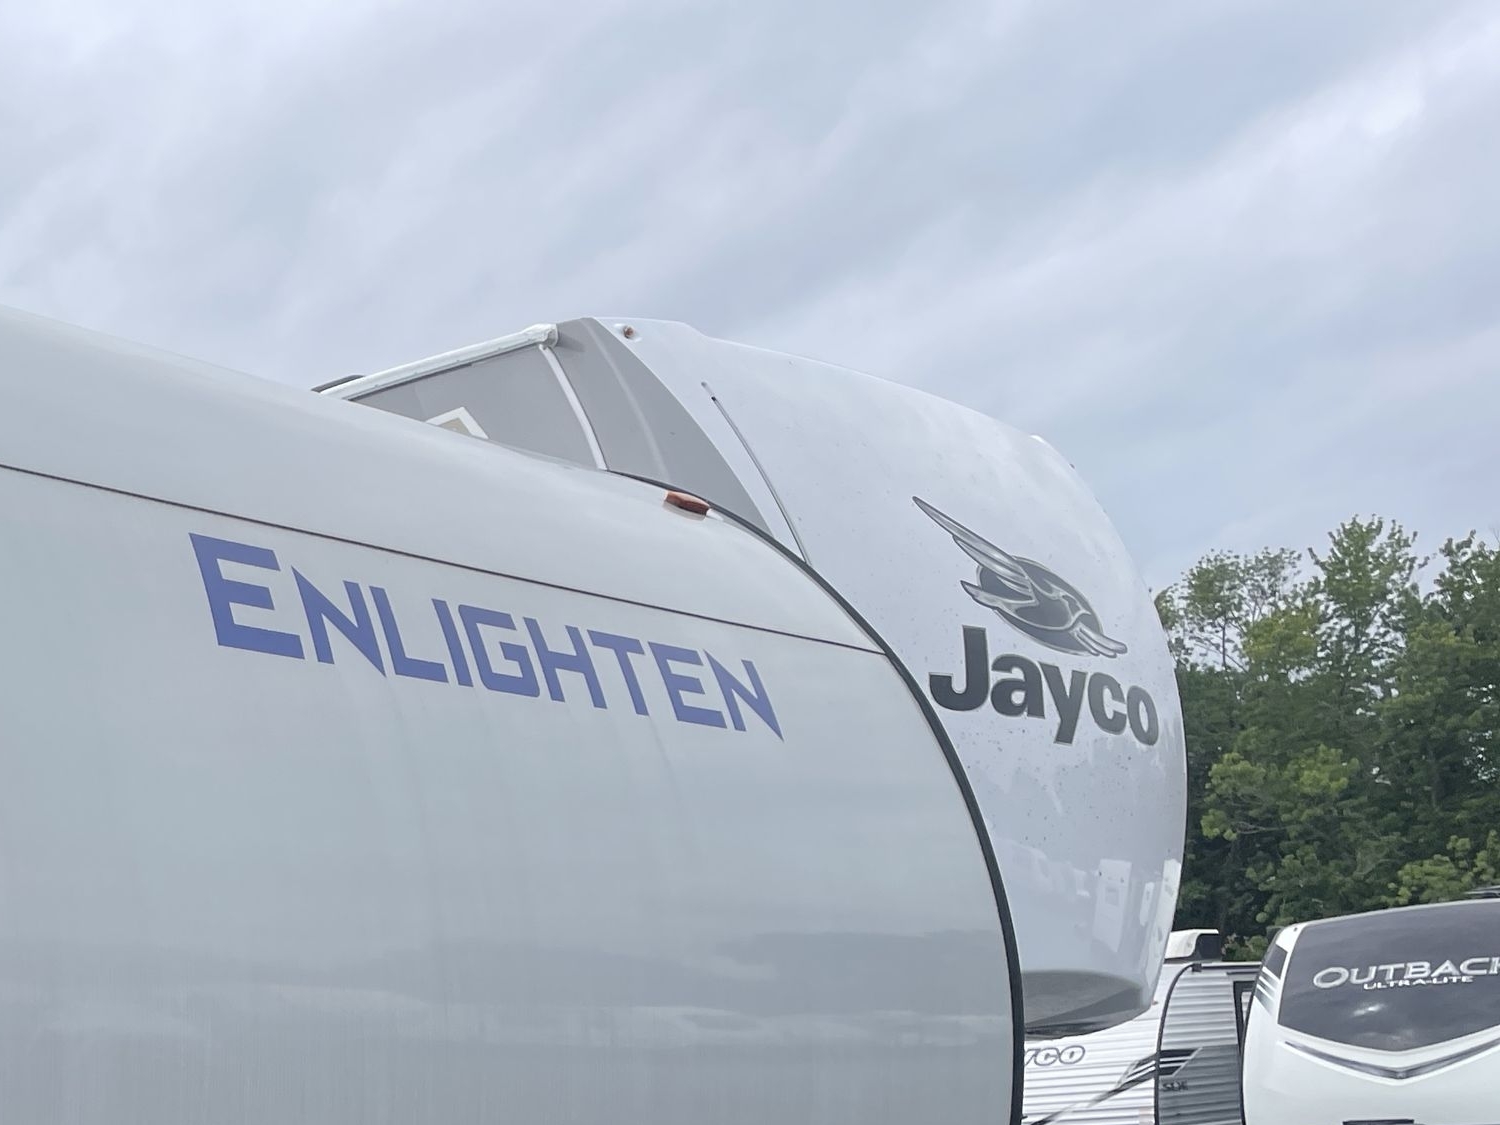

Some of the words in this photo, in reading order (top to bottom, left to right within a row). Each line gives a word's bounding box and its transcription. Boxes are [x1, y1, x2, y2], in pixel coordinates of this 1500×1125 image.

[189, 532, 784, 741] ENLIGHTEN
[928, 625, 1160, 747] Jayco
[1363, 975, 1475, 990] ULTRA-LITE
